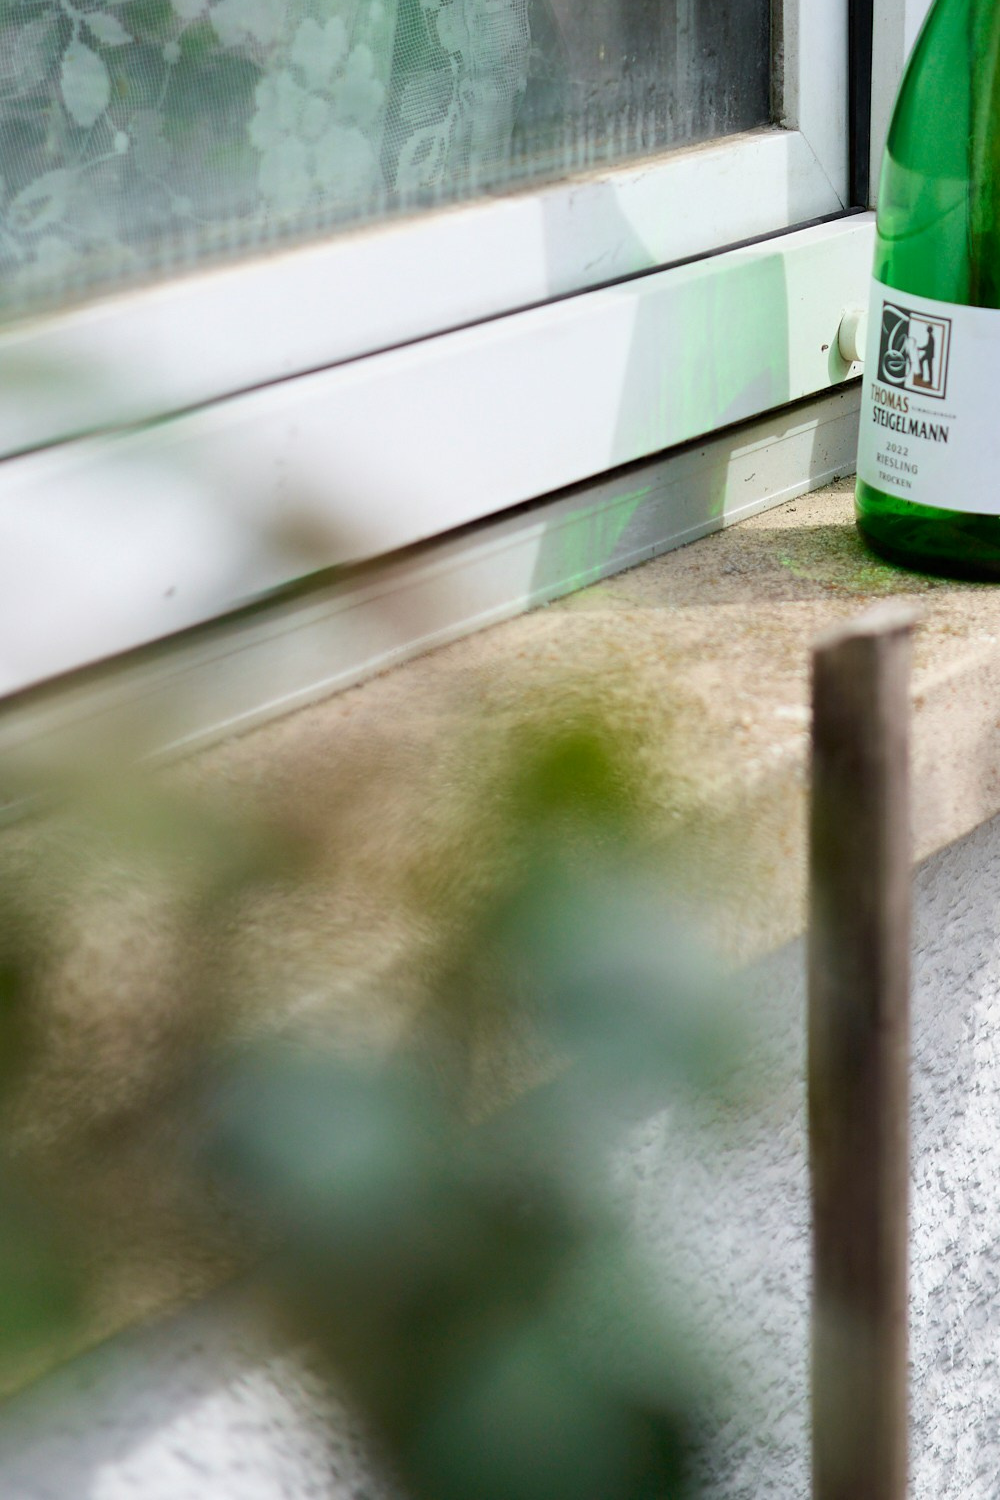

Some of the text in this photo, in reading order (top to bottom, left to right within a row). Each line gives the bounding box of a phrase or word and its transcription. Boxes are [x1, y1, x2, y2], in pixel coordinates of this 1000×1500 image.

[871, 383, 910, 414] THOMAS
[873, 405, 949, 443] STEIGELMANN
[886, 441, 909, 456] 2022
[876, 452, 918, 475] RIESLING
[879, 470, 912, 489] TROCKEN
